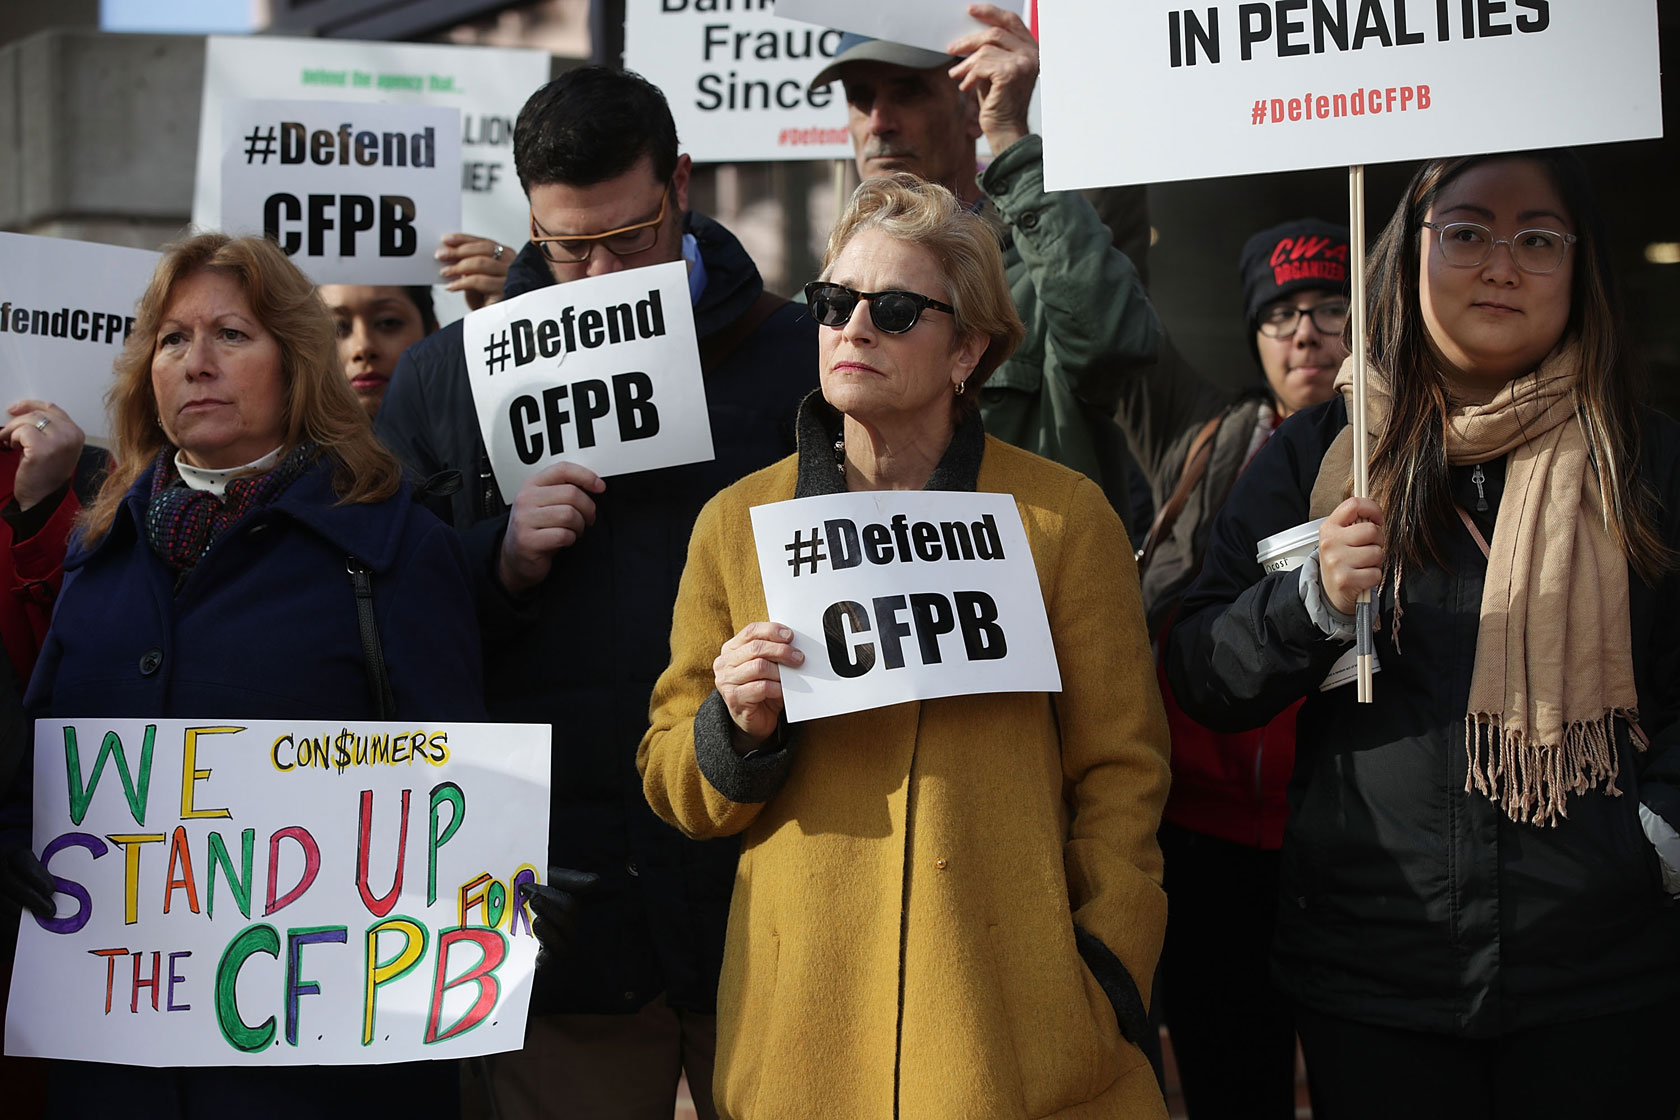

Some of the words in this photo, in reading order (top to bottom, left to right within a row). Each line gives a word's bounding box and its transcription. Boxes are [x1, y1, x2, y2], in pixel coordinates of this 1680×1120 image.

[1168, 6, 1221, 68] IN
[1239, 0, 1550, 62] PENALTIES
[352, 69, 372, 87] the
[377, 73, 424, 92] agency
[696, 72, 832, 111] Since
[1251, 84, 1431, 125] #DefendCFPB
[245, 121, 436, 168] #Defend
[264, 192, 418, 258] CFPB
[1269, 235, 1347, 267] CWA
[484, 289, 666, 376] #Defend
[509, 371, 661, 465] CFPB
[785, 514, 1006, 577] #Defend
[822, 590, 1008, 678] CFPB
[63, 724, 248, 826] WE
[34, 825, 321, 934] STAND
[355, 781, 466, 918] UP
[457, 862, 541, 938] FOR
[88, 948, 192, 1015] THE
[215, 914, 510, 1053] C.F.P.B.
